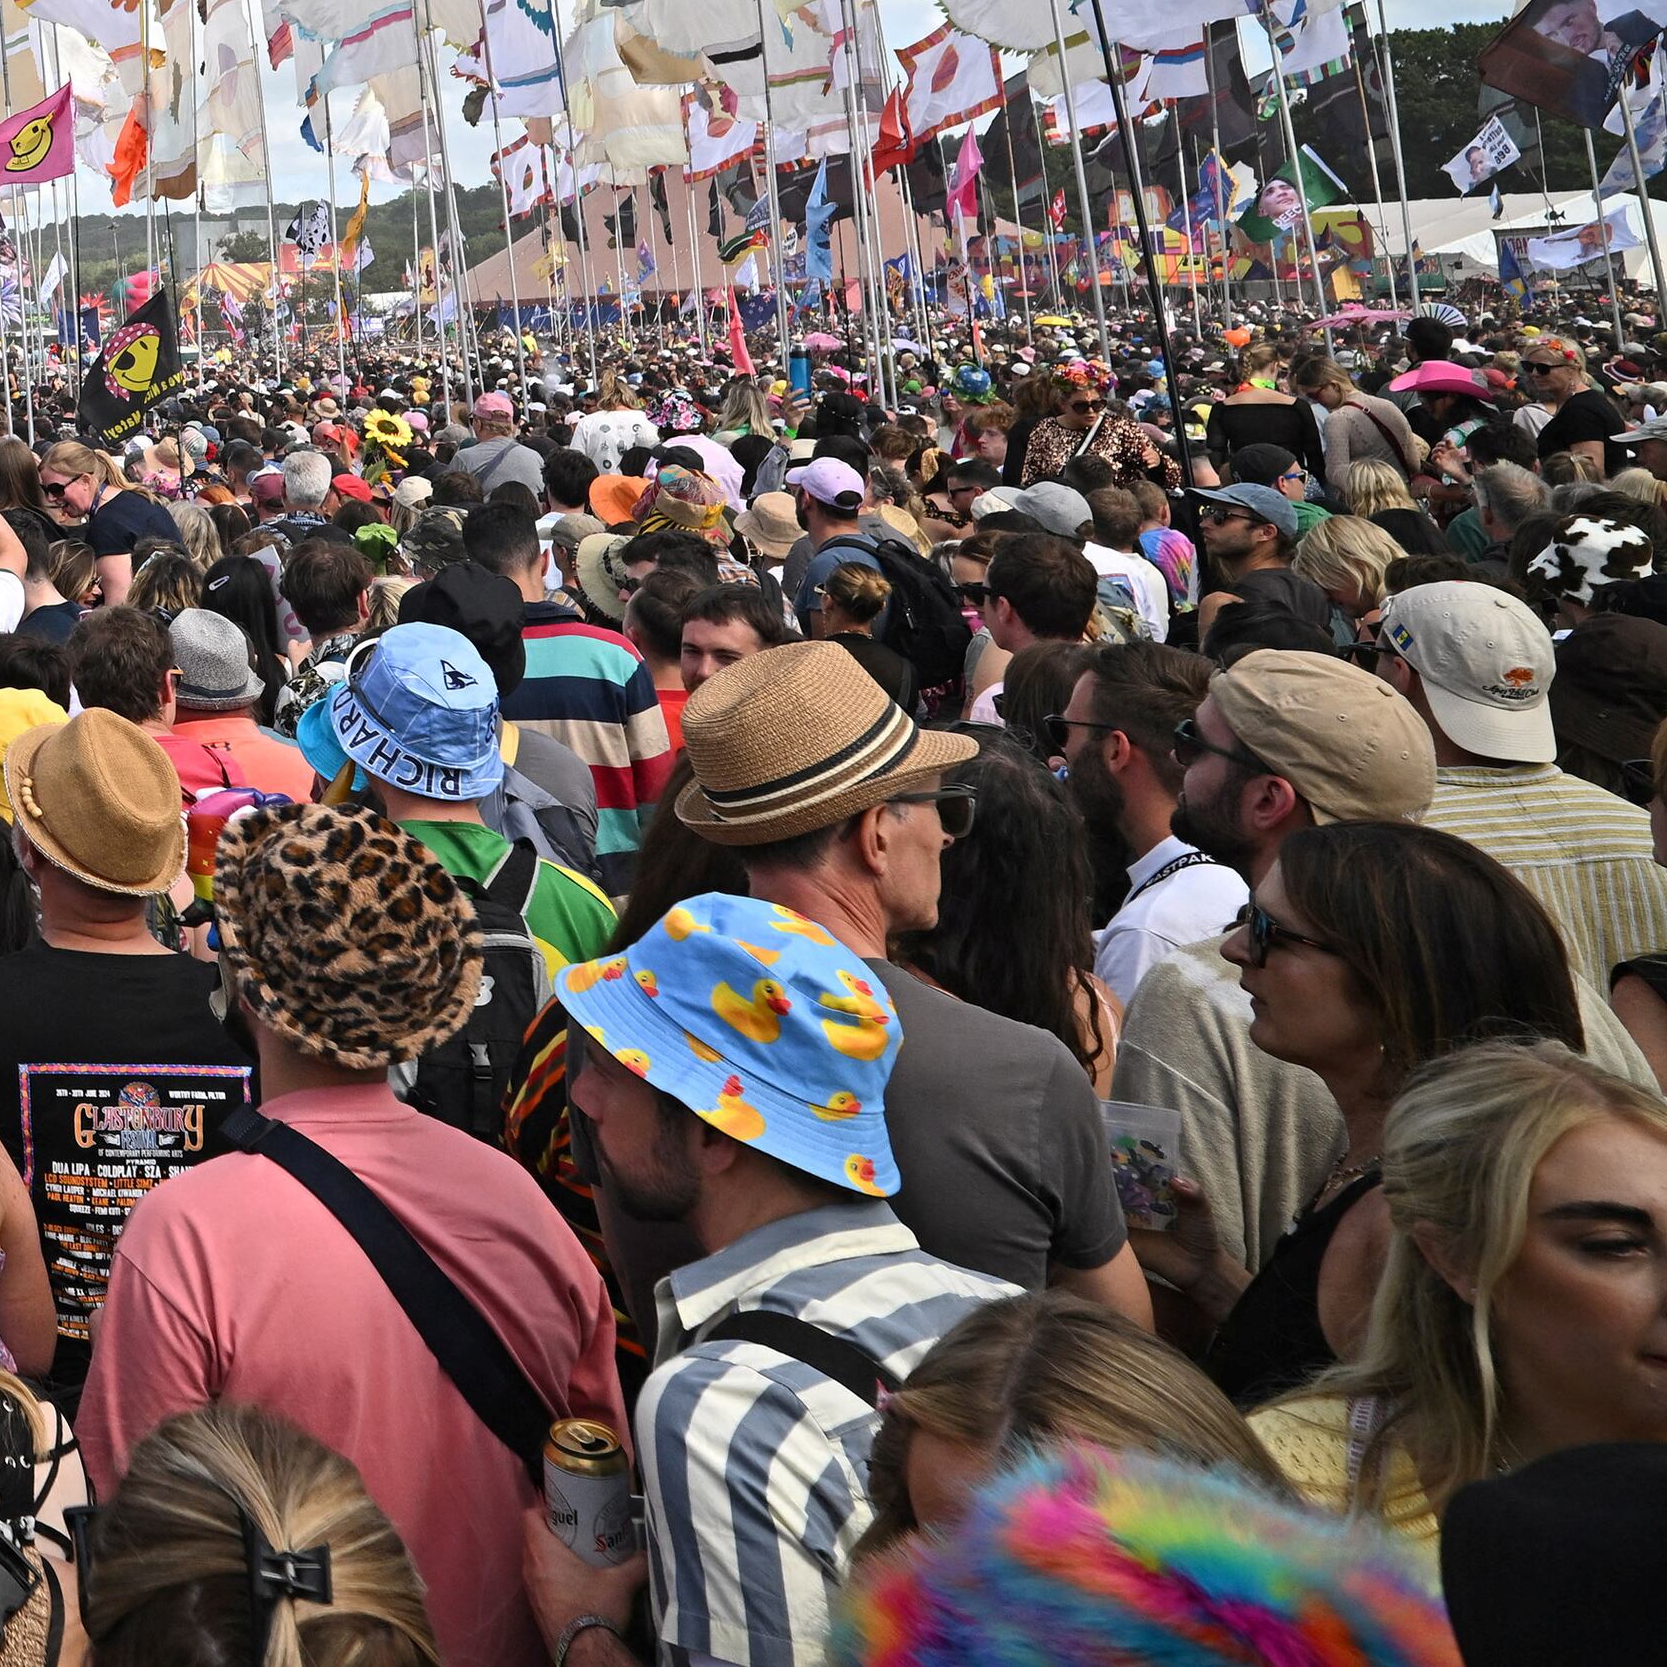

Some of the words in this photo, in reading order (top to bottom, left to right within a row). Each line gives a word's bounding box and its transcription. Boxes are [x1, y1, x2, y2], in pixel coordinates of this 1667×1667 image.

[1117, 192, 1162, 224] BR
[332, 686, 462, 796] RICHARD
[73, 1103, 206, 1152] GLASTONBURY
[171, 1150, 183, 1158] ARTS
[52, 1161, 69, 1174] DUA
[71, 1162, 91, 1176] LIPA
[97, 1165, 138, 1179] COLDPLAY
[144, 1165, 162, 1178] SZA
[113, 1177, 136, 1189] LITTLE
